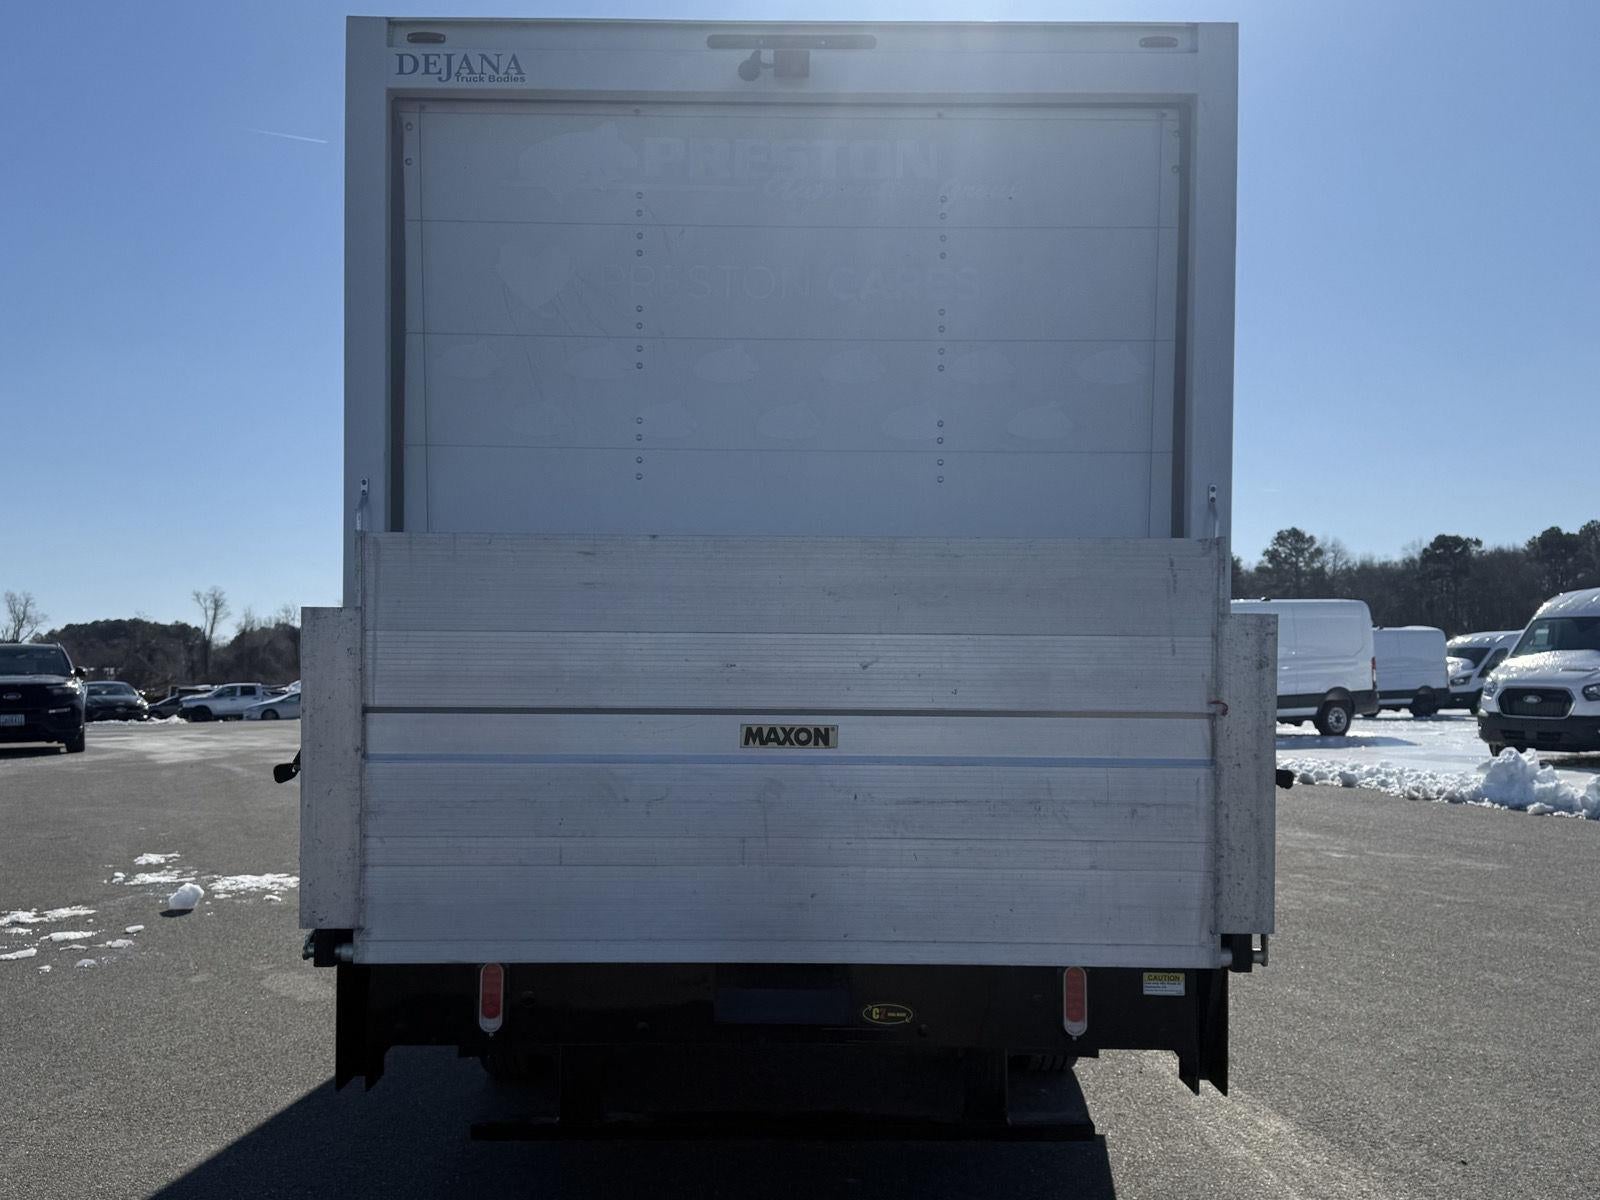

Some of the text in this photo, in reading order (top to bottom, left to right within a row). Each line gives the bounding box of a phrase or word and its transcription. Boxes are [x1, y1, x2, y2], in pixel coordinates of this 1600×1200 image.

[395, 53, 526, 83] DEJANA
[455, 73, 526, 83] Truck Bodies
[644, 136, 938, 179] PRESTON
[601, 264, 812, 300] PRESTON
[743, 726, 830, 747] MAXON
[1147, 974, 1180, 982] CAUTION
